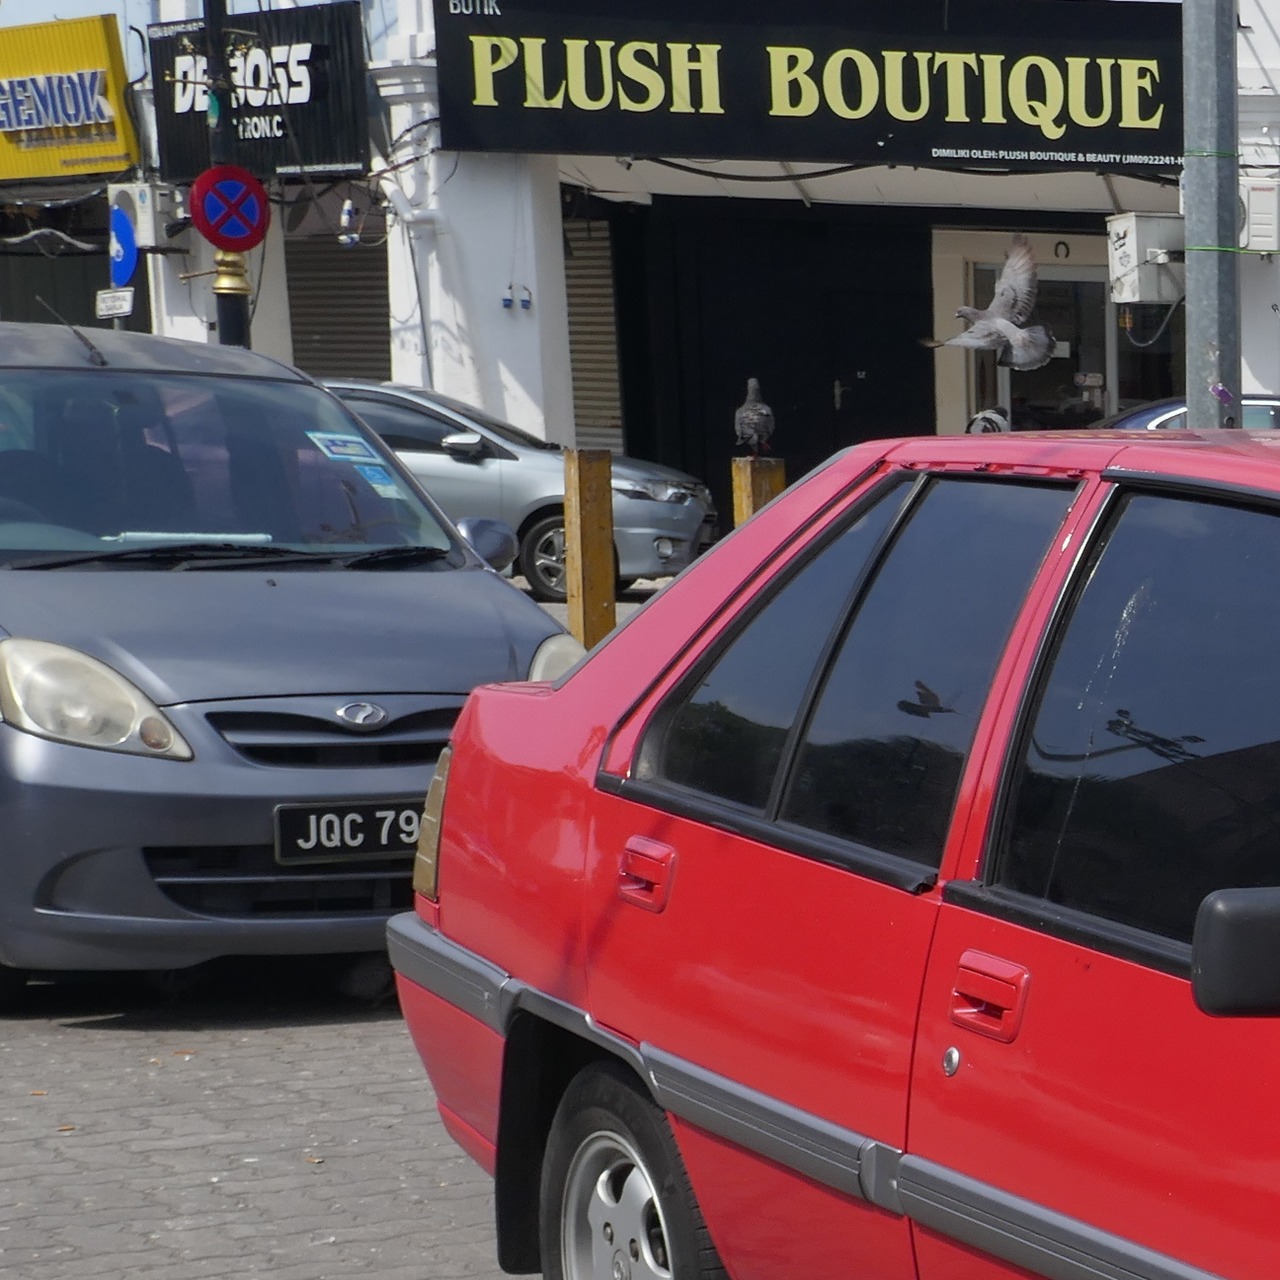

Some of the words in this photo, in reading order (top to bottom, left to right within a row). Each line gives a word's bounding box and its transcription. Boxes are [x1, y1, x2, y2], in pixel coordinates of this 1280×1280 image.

[450, 0, 501, 16] BUTIK
[469, 35, 725, 115] PLUSH
[766, 45, 1164, 140] BOUTIQUE
[932, 148, 970, 159] DIMILIKI
[971, 149, 998, 160] OLEH:
[999, 150, 1028, 161] PLUSH
[1030, 151, 1077, 163] BOUTIQUE
[1077, 152, 1085, 162] &
[1086, 153, 1122, 164] BEAUTY
[297, 813, 364, 850] JQC
